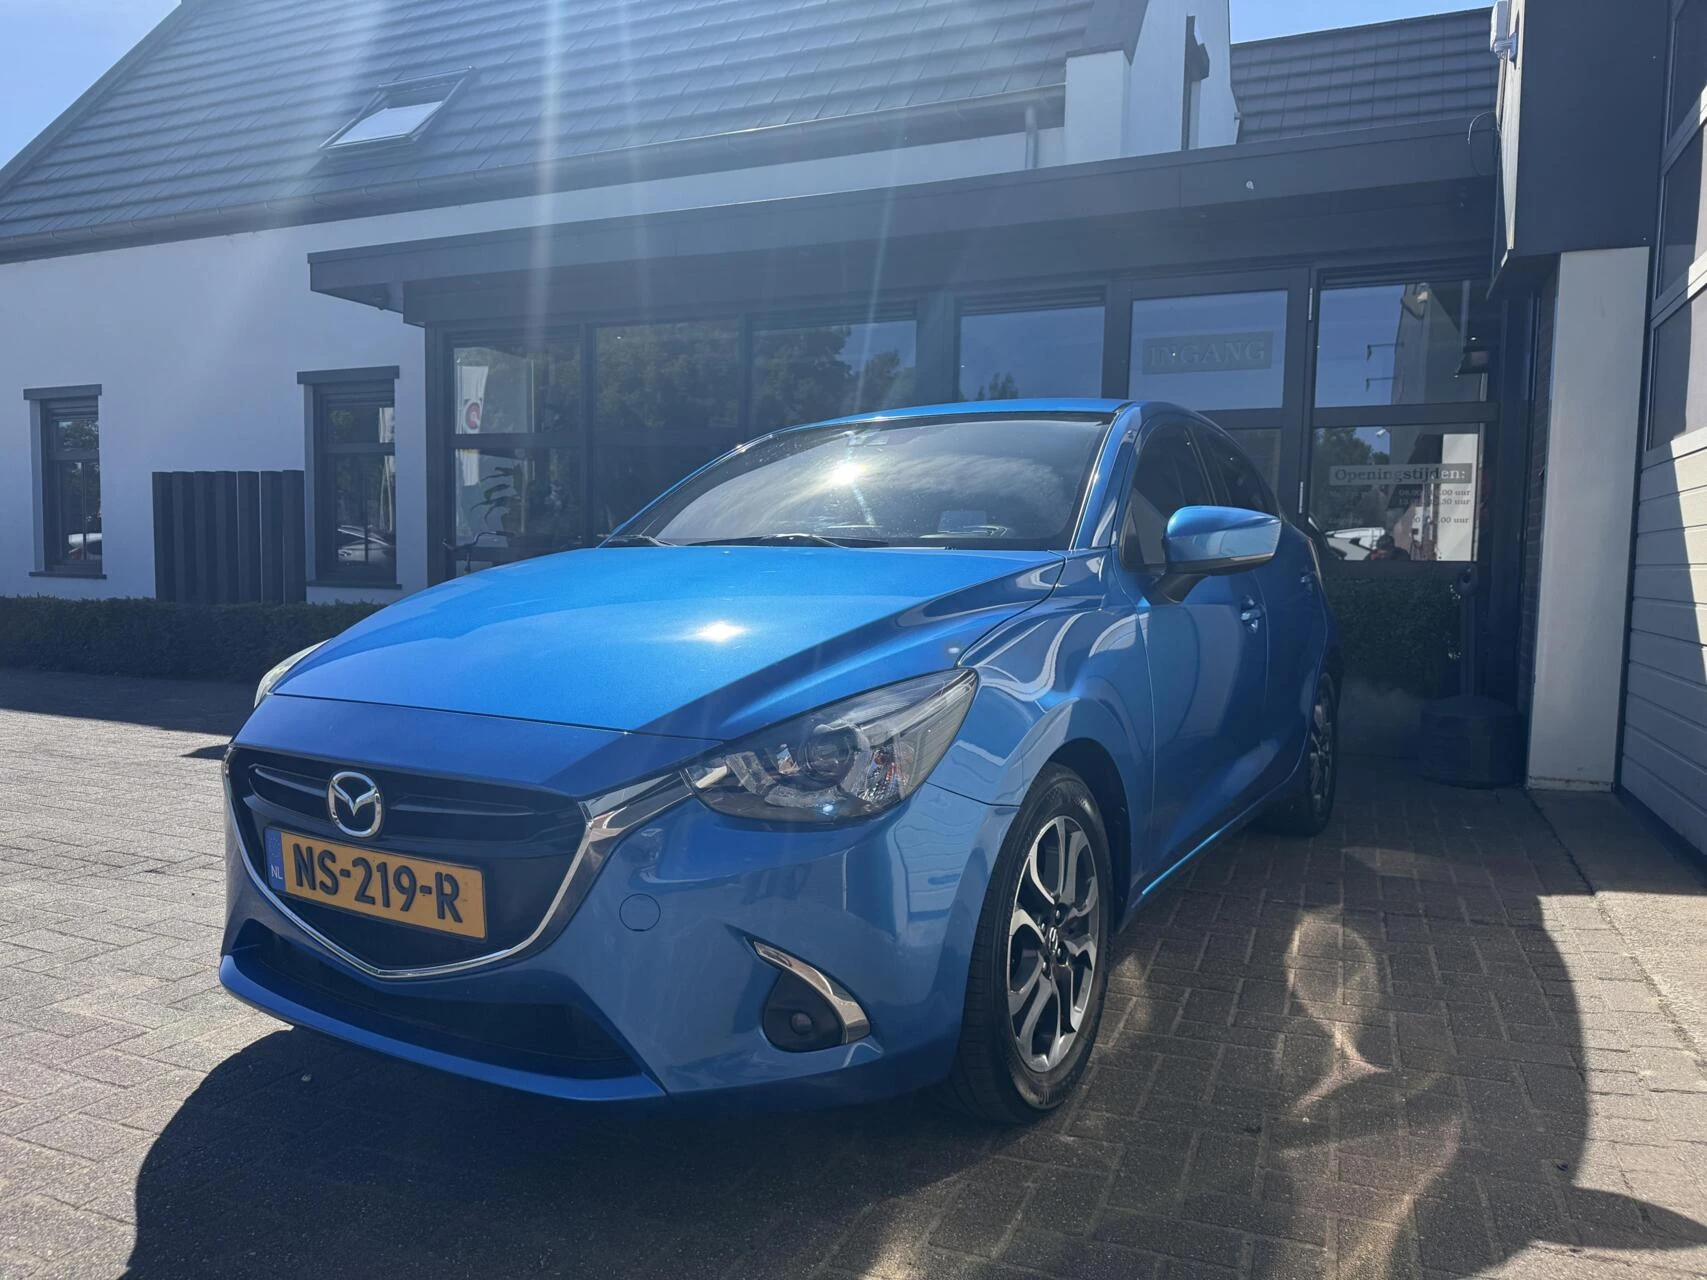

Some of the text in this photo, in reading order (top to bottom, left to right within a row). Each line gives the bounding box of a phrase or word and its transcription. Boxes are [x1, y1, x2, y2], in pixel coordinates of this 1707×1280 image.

[1148, 337, 1265, 367] INGANG
[1334, 466, 1466, 482] Openingstijden:
[271, 865, 283, 880] NL
[292, 843, 463, 923] NS-219-R
